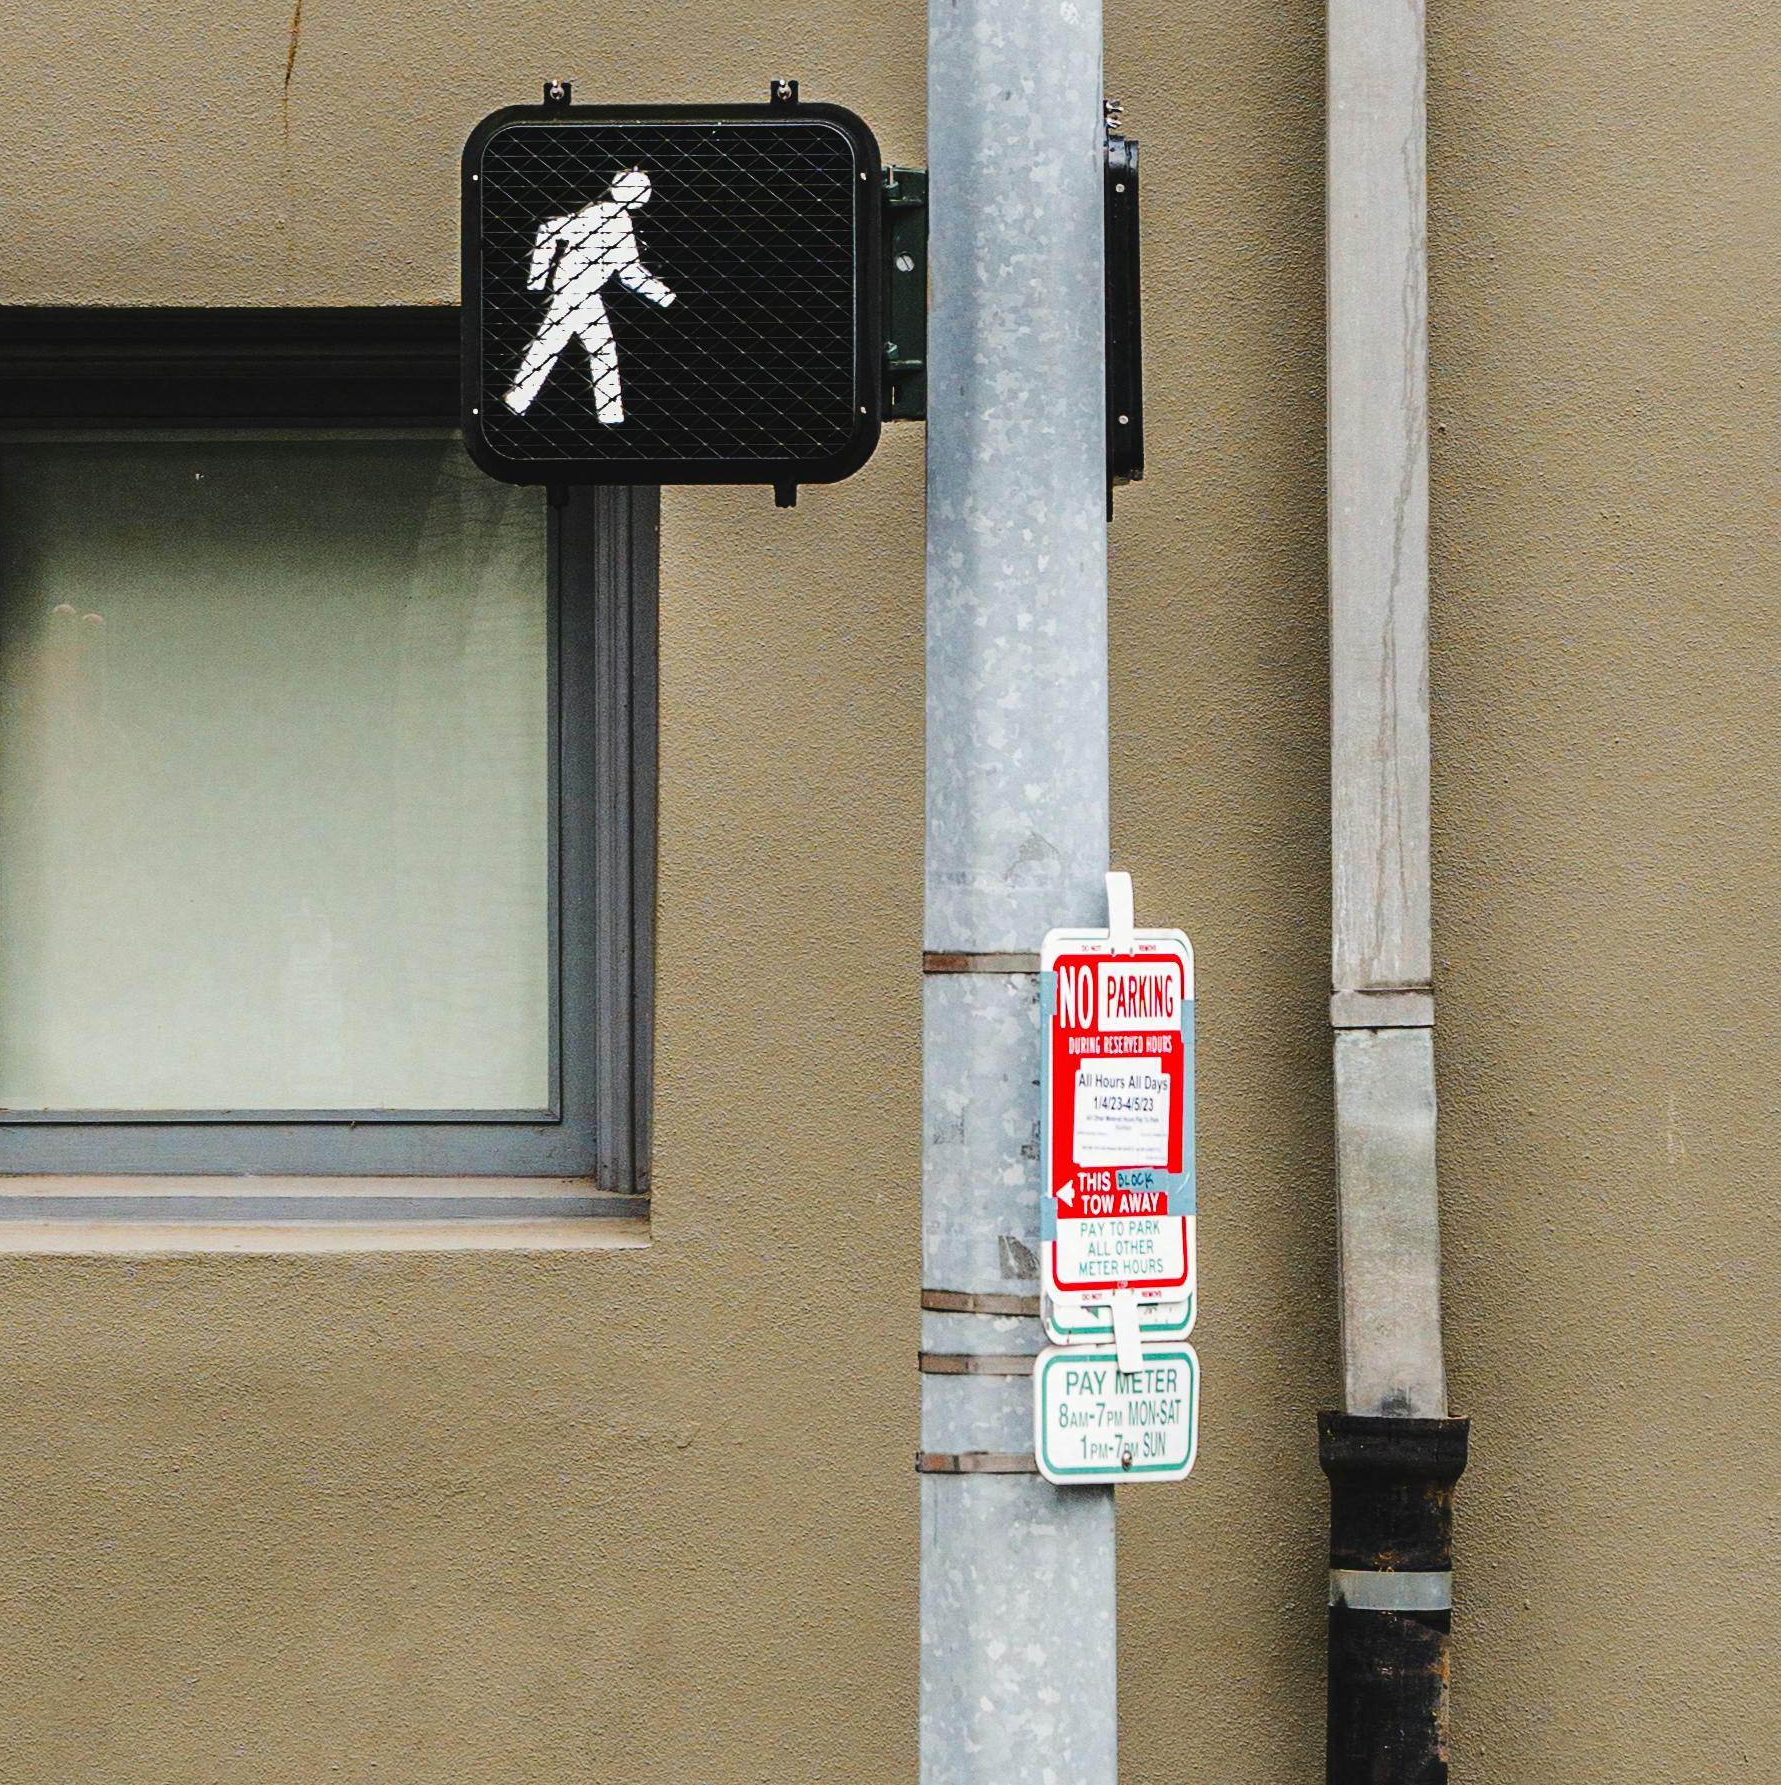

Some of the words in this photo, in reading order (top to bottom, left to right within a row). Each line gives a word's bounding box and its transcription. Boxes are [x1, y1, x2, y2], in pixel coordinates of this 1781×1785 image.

[1059, 965, 1094, 1030] NO
[1106, 974, 1174, 1018] PARKING
[1068, 1036, 1101, 1055] DURING
[1103, 1035, 1144, 1054] RESERVED
[1146, 1034, 1173, 1054] HOURS
[1078, 1073, 1093, 1087] All
[1095, 1073, 1125, 1089] Hours
[1128, 1075, 1142, 1089] All
[1144, 1075, 1168, 1094] Days
[1093, 1096, 1154, 1112] 1/4/23-4/5/23
[1076, 1171, 1112, 1192] THIS
[1117, 1172, 1154, 1189] BLOCK
[1081, 1194, 1115, 1215] TOW
[1118, 1192, 1160, 1214] AWAY
[1080, 1222, 1106, 1238] PAY
[1110, 1221, 1125, 1237] TO
[1129, 1220, 1161, 1235] PARK
[1087, 1241, 1111, 1257] ALL
[1115, 1240, 1154, 1256] OTHER
[1078, 1260, 1119, 1277] METER
[1123, 1258, 1164, 1274] HOURS
[1066, 1370, 1107, 1395] PAY
[1115, 1368, 1177, 1394] METER
[1058, 1402, 1123, 1428] 8AM-7PM
[1128, 1399, 1182, 1426] MON-SAT
[1143, 1431, 1166, 1457] SUN
